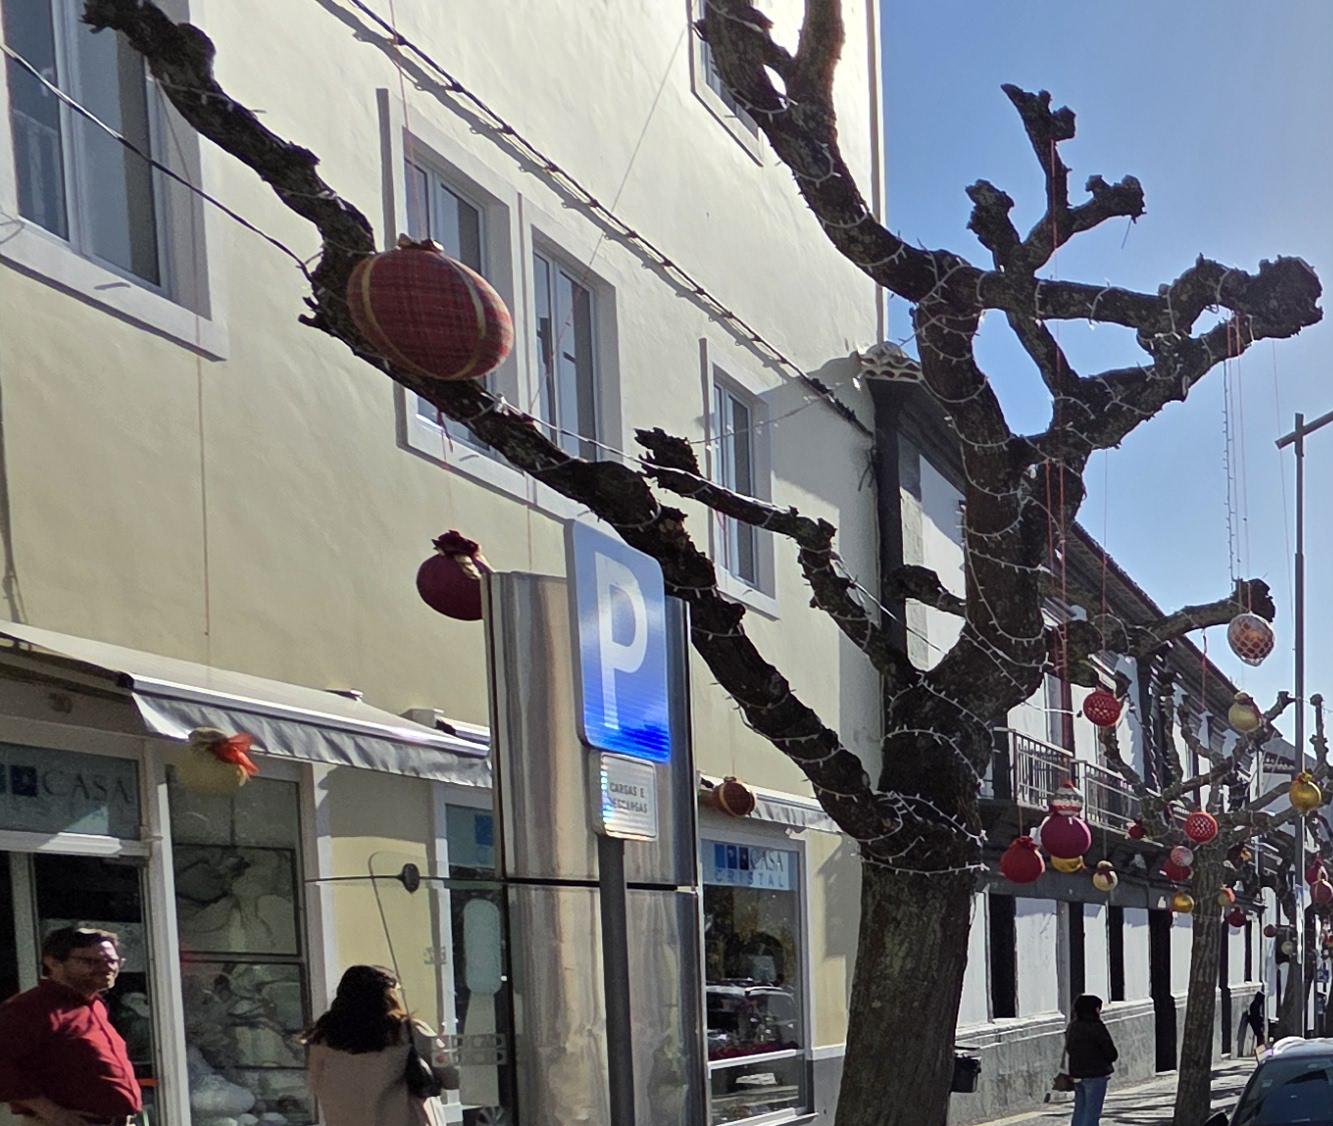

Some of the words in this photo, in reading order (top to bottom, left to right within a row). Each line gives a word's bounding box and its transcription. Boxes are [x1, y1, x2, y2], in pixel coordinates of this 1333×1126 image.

[595, 551, 648, 730] P
[42, 769, 133, 804] CASA
[749, 847, 784, 873] CASA
[714, 868, 785, 888] CRISTAL
